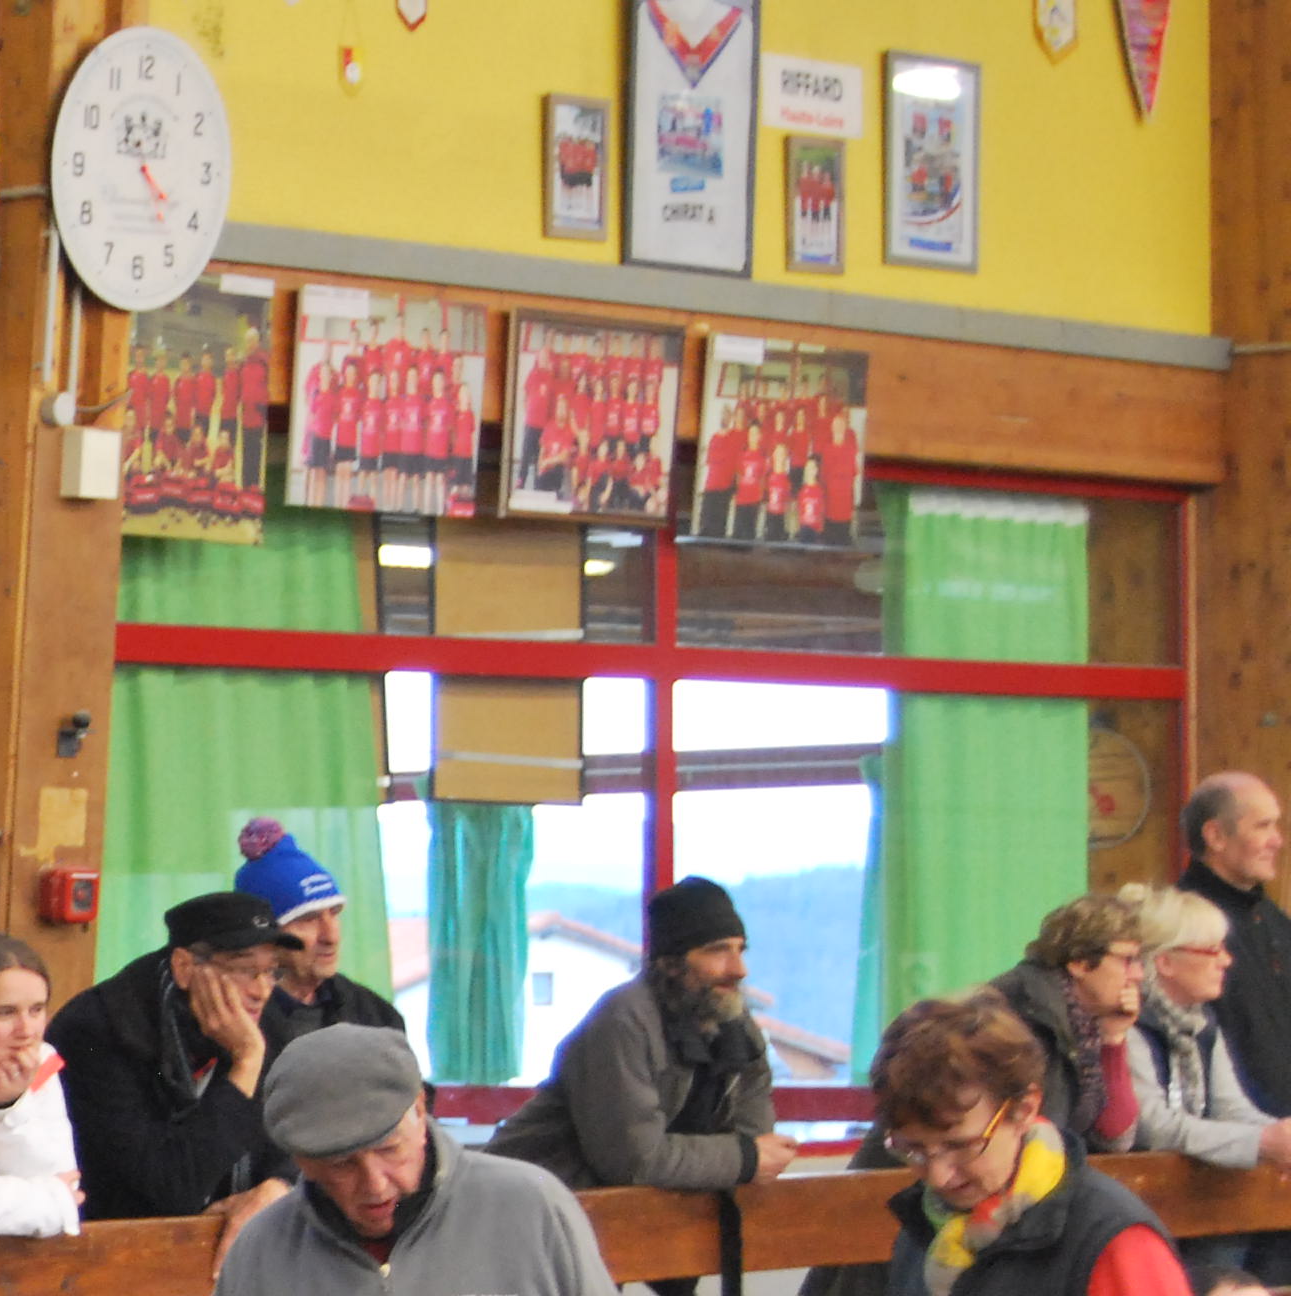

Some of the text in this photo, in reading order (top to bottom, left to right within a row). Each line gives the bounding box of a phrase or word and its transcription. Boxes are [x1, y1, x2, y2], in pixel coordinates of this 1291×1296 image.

[109, 67, 121, 91] 11
[138, 55, 155, 80] 12
[781, 69, 843, 102] RIFFARD
[83, 104, 100, 130] 10
[193, 112, 205, 137] 2
[72, 152, 85, 177] 9
[200, 161, 212, 186] 3
[79, 201, 93, 225] 8
[187, 210, 199, 232] 4
[103, 242, 115, 265] 7
[163, 244, 175, 268] 5
[132, 255, 144, 280] 6
